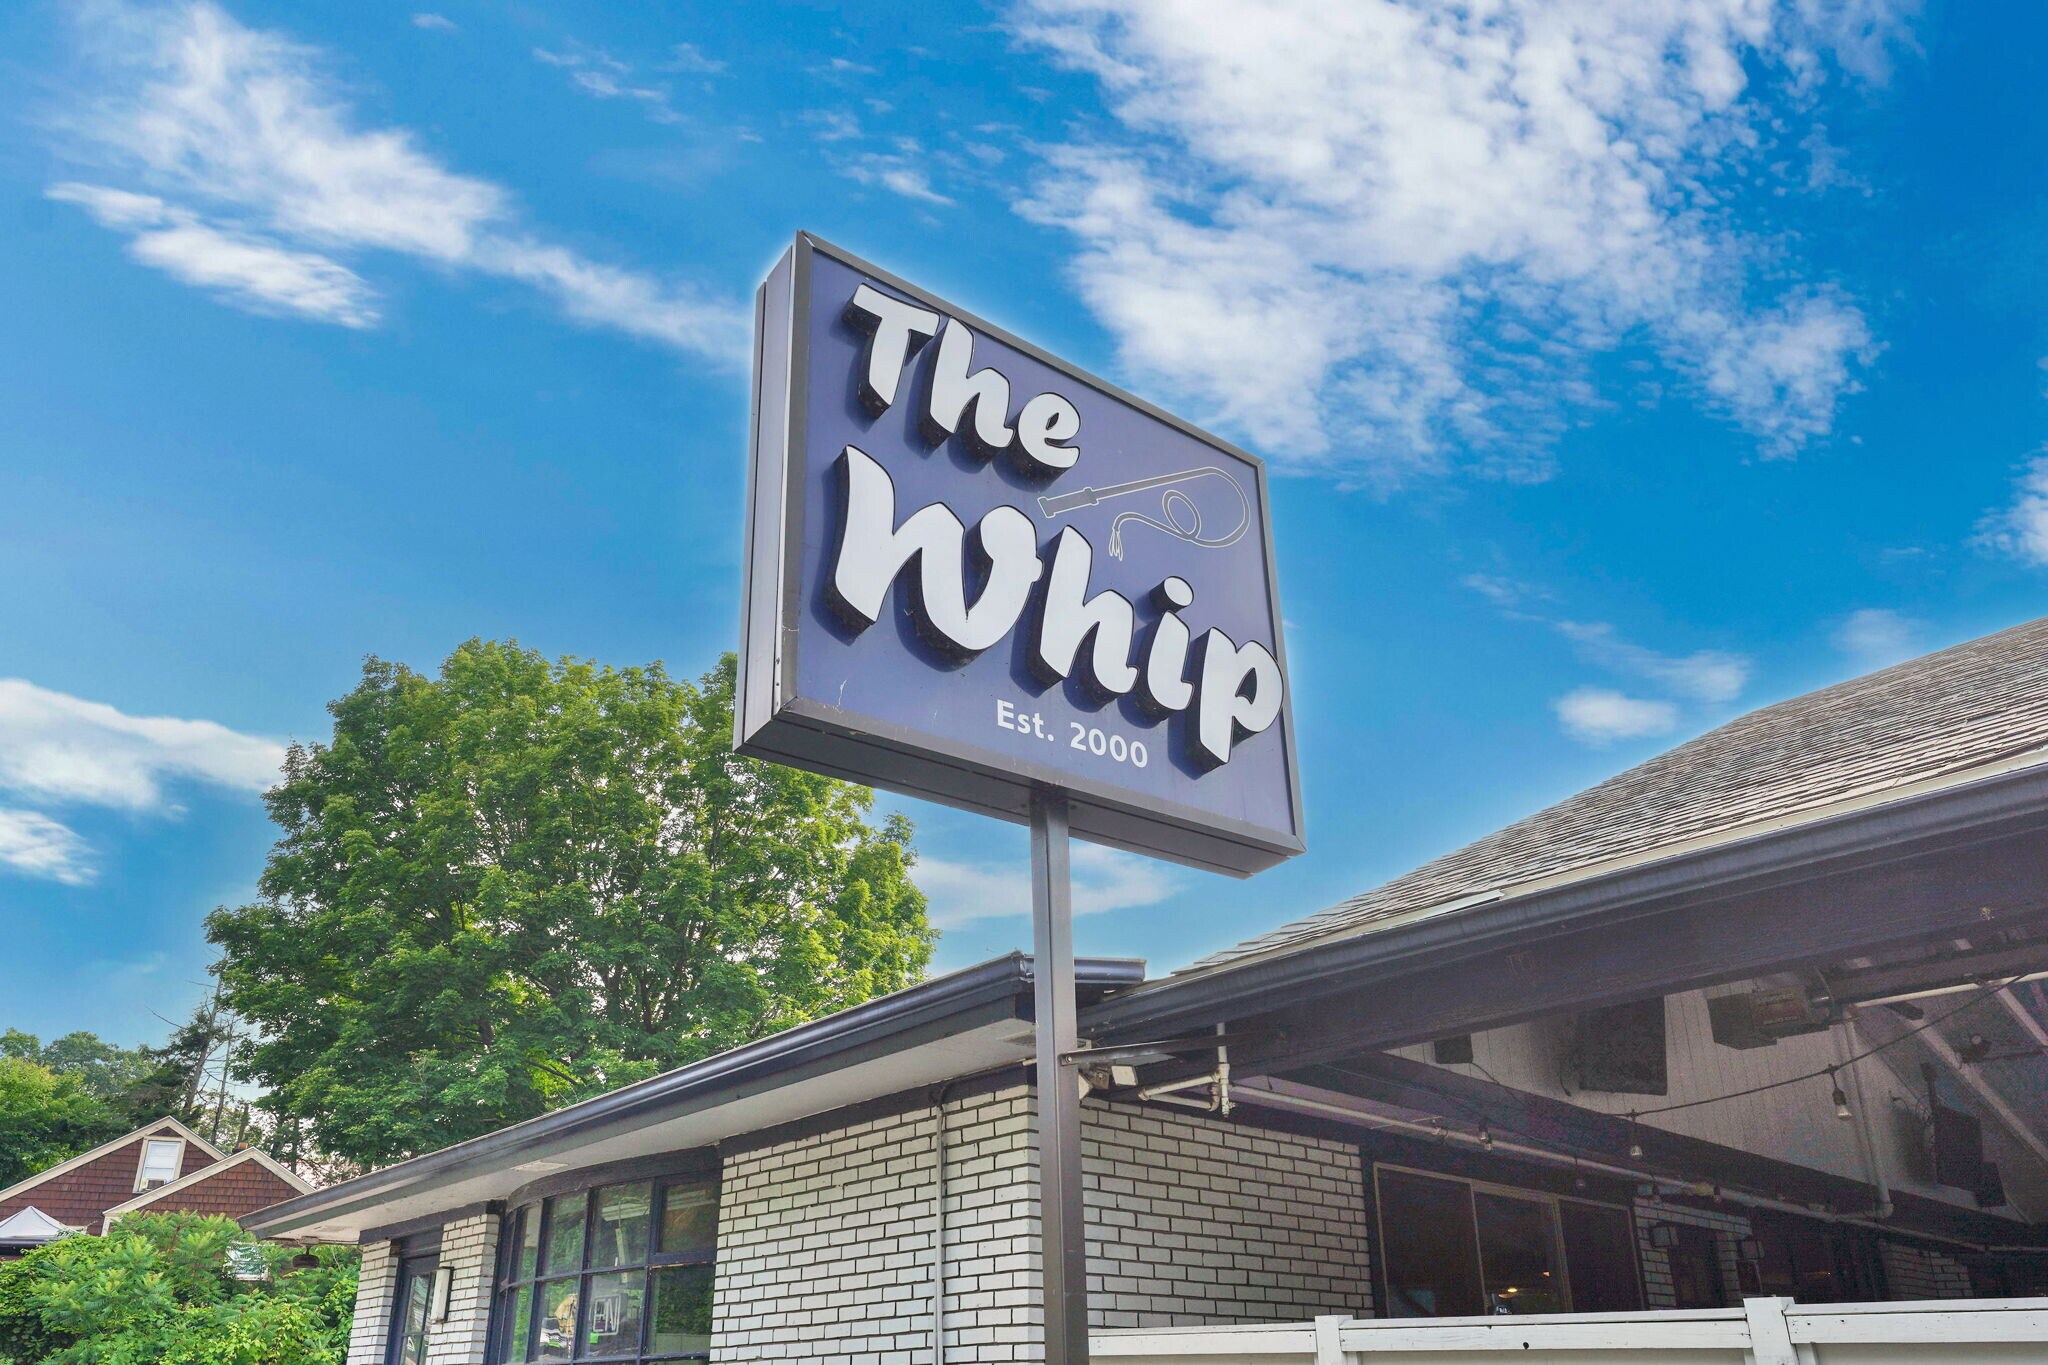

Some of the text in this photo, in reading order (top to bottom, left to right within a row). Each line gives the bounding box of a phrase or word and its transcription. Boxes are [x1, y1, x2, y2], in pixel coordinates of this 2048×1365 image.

[851, 282, 1080, 469] The
[833, 444, 1283, 764] Whip
[997, 699, 1148, 768] Est. 2000
